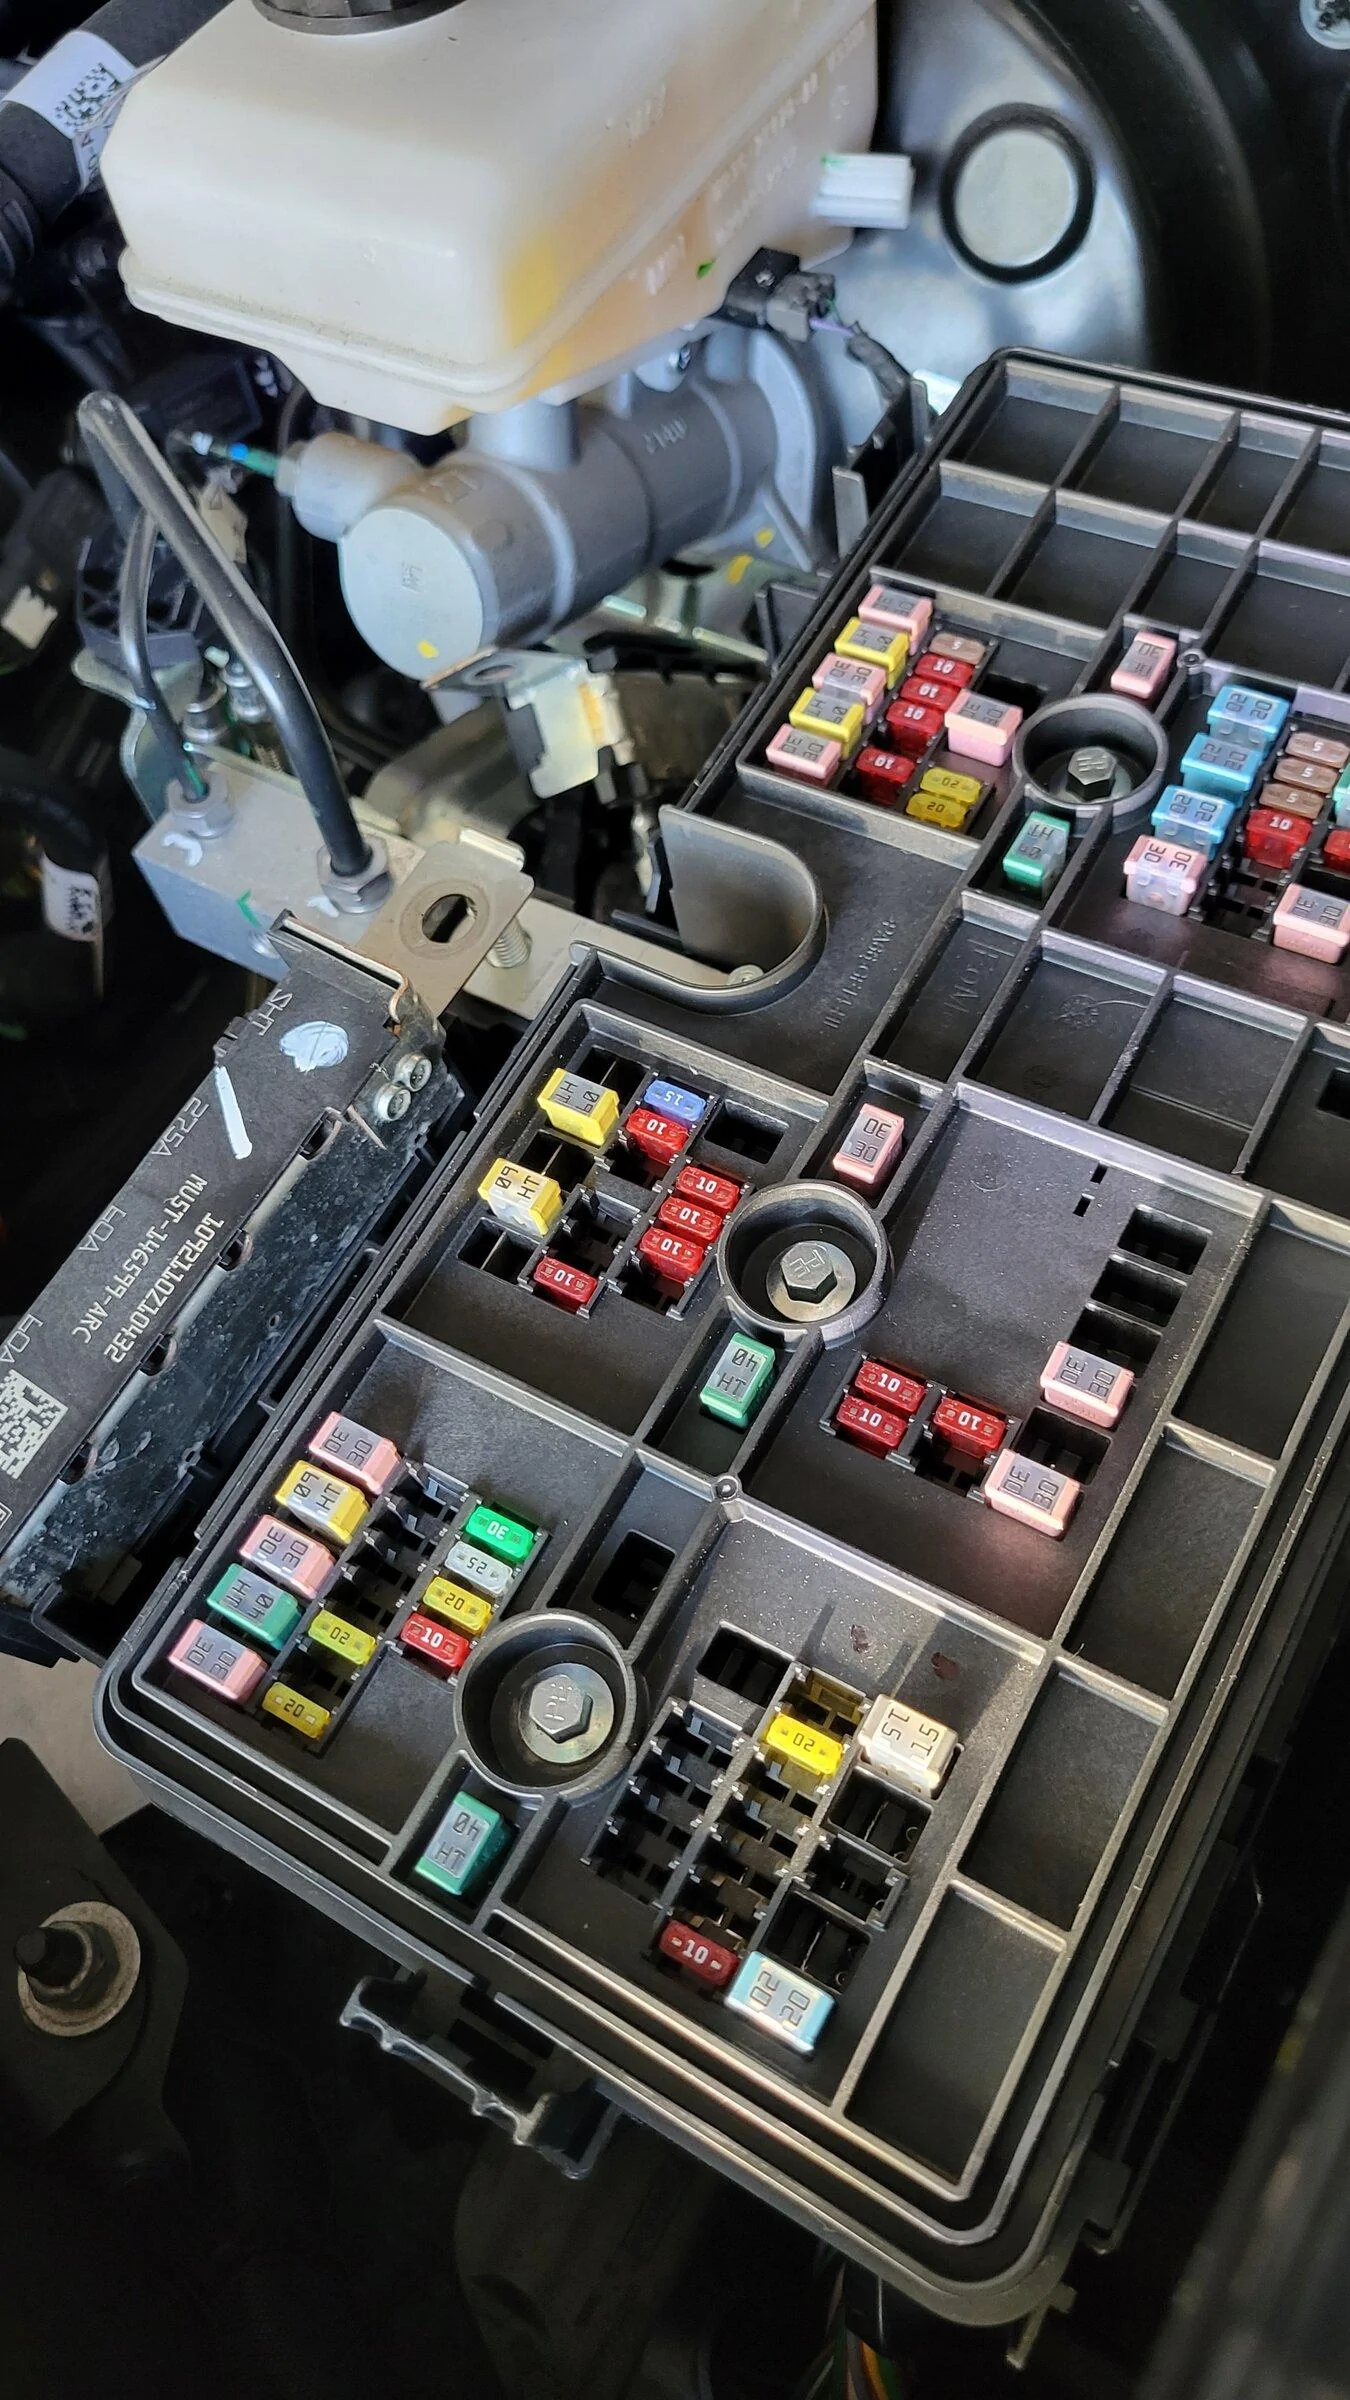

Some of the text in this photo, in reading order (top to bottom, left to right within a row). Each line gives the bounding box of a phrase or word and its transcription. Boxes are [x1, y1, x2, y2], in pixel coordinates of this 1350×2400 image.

[952, 641, 963, 650] 5
[933, 660, 956, 674] 10
[919, 684, 940, 698] 10
[904, 706, 925, 720] 10
[1313, 741, 1324, 752] 5
[874, 755, 895, 770] 10
[1302, 767, 1313, 778] 5
[927, 801, 946, 813] 20
[1286, 793, 1298, 803] 5
[1269, 815, 1292, 830] 10
[1168, 850, 1192, 872] 30
[554, 1080, 578, 1104] HT
[663, 1090, 684, 1106] 15
[151, 1097, 210, 1158] 275A
[647, 1118, 668, 1136] 10
[863, 1116, 893, 1140] 30
[517, 1175, 541, 1200] HT
[695, 1176, 718, 1194] 10
[678, 1207, 701, 1225] 10
[660, 1238, 683, 1257] 10
[553, 1268, 576, 1287] 10
[715, 1369, 747, 1396] HT
[877, 1373, 901, 1392] 10
[859, 1407, 883, 1427] 10
[958, 1411, 982, 1431] 10
[323, 1427, 350, 1453] 30
[347, 1439, 373, 1465] 30
[293, 1471, 321, 1499] 60
[316, 1482, 341, 1511] HT
[259, 1526, 286, 1555] 30
[486, 1520, 509, 1541] 30
[281, 1540, 309, 1568] 30
[230, 1579, 252, 1607] HT
[444, 1592, 466, 1612] 20
[421, 1628, 444, 1649] 10
[187, 1636, 214, 1666] 30
[209, 1651, 237, 1681] 30
[283, 1698, 306, 1718] 20
[881, 1708, 911, 1743] 15
[792, 1733, 816, 1752] 20
[910, 1723, 940, 1759] 15
[451, 1811, 481, 1840] 40
[434, 1841, 467, 1871] HT
[750, 1971, 781, 2008] 20
